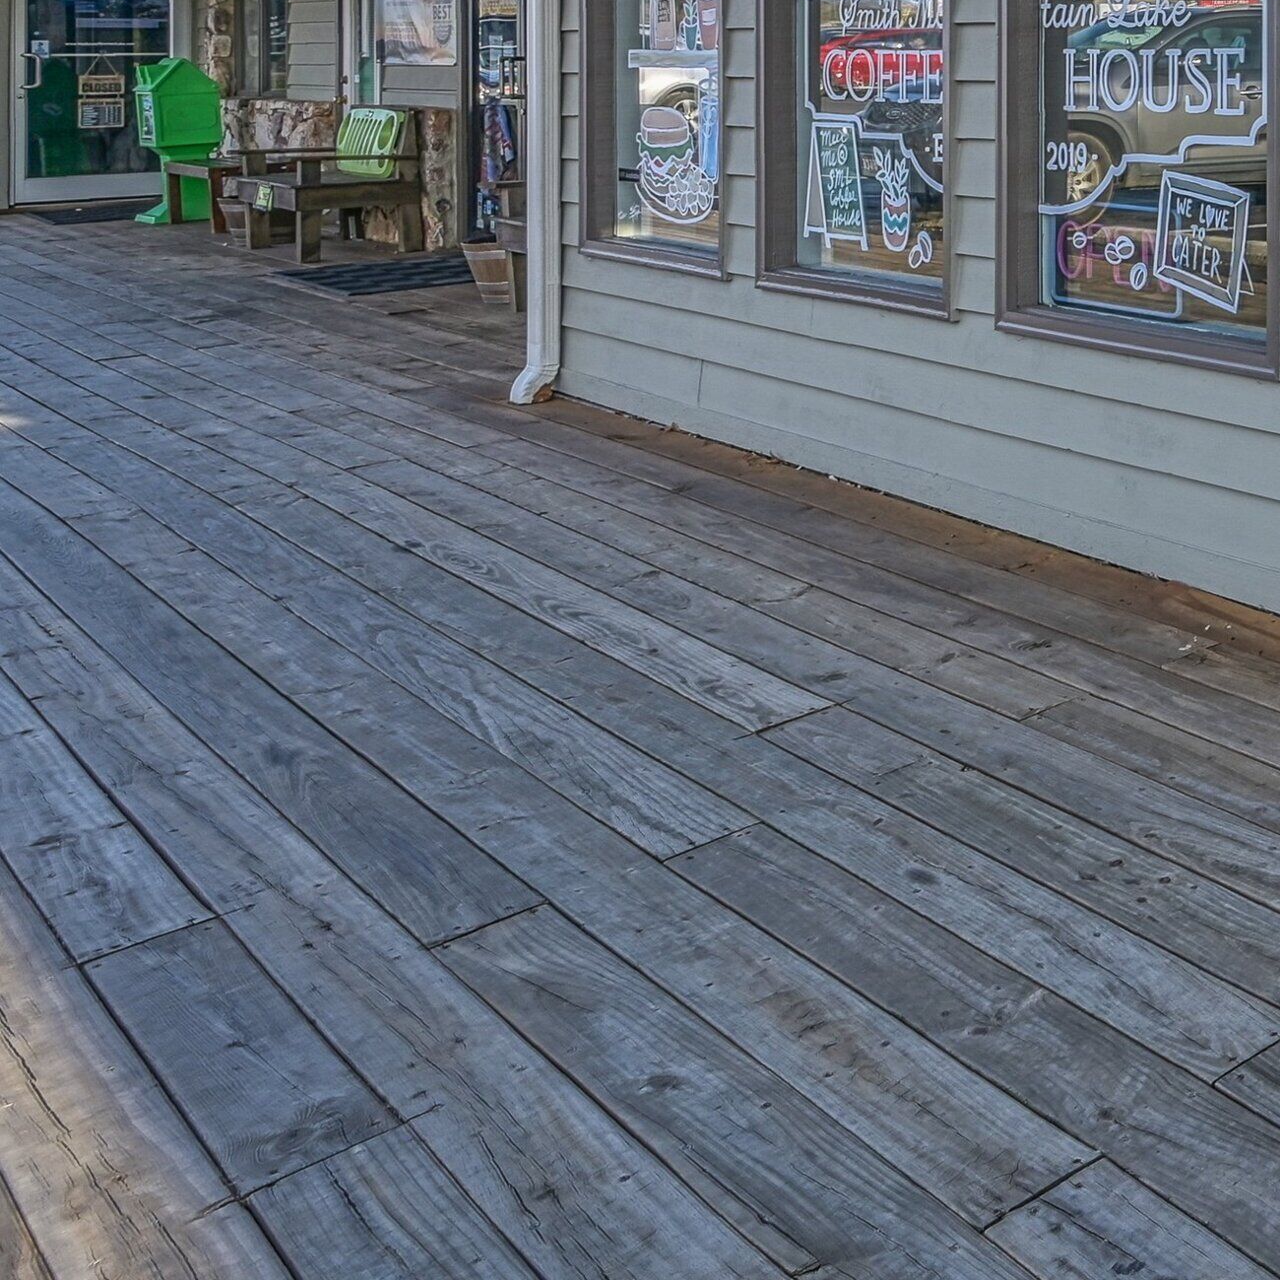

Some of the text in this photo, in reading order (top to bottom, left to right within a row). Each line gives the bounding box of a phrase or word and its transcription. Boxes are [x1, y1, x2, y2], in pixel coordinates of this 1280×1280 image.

[432, 5, 452, 19] BEST
[81, 83, 123, 93] CLOSED
[1062, 48, 1246, 116] HOUSE
[1175, 196, 1193, 219] WE
[1190, 224, 1206, 242] TO
[1171, 234, 1223, 285] CATER
